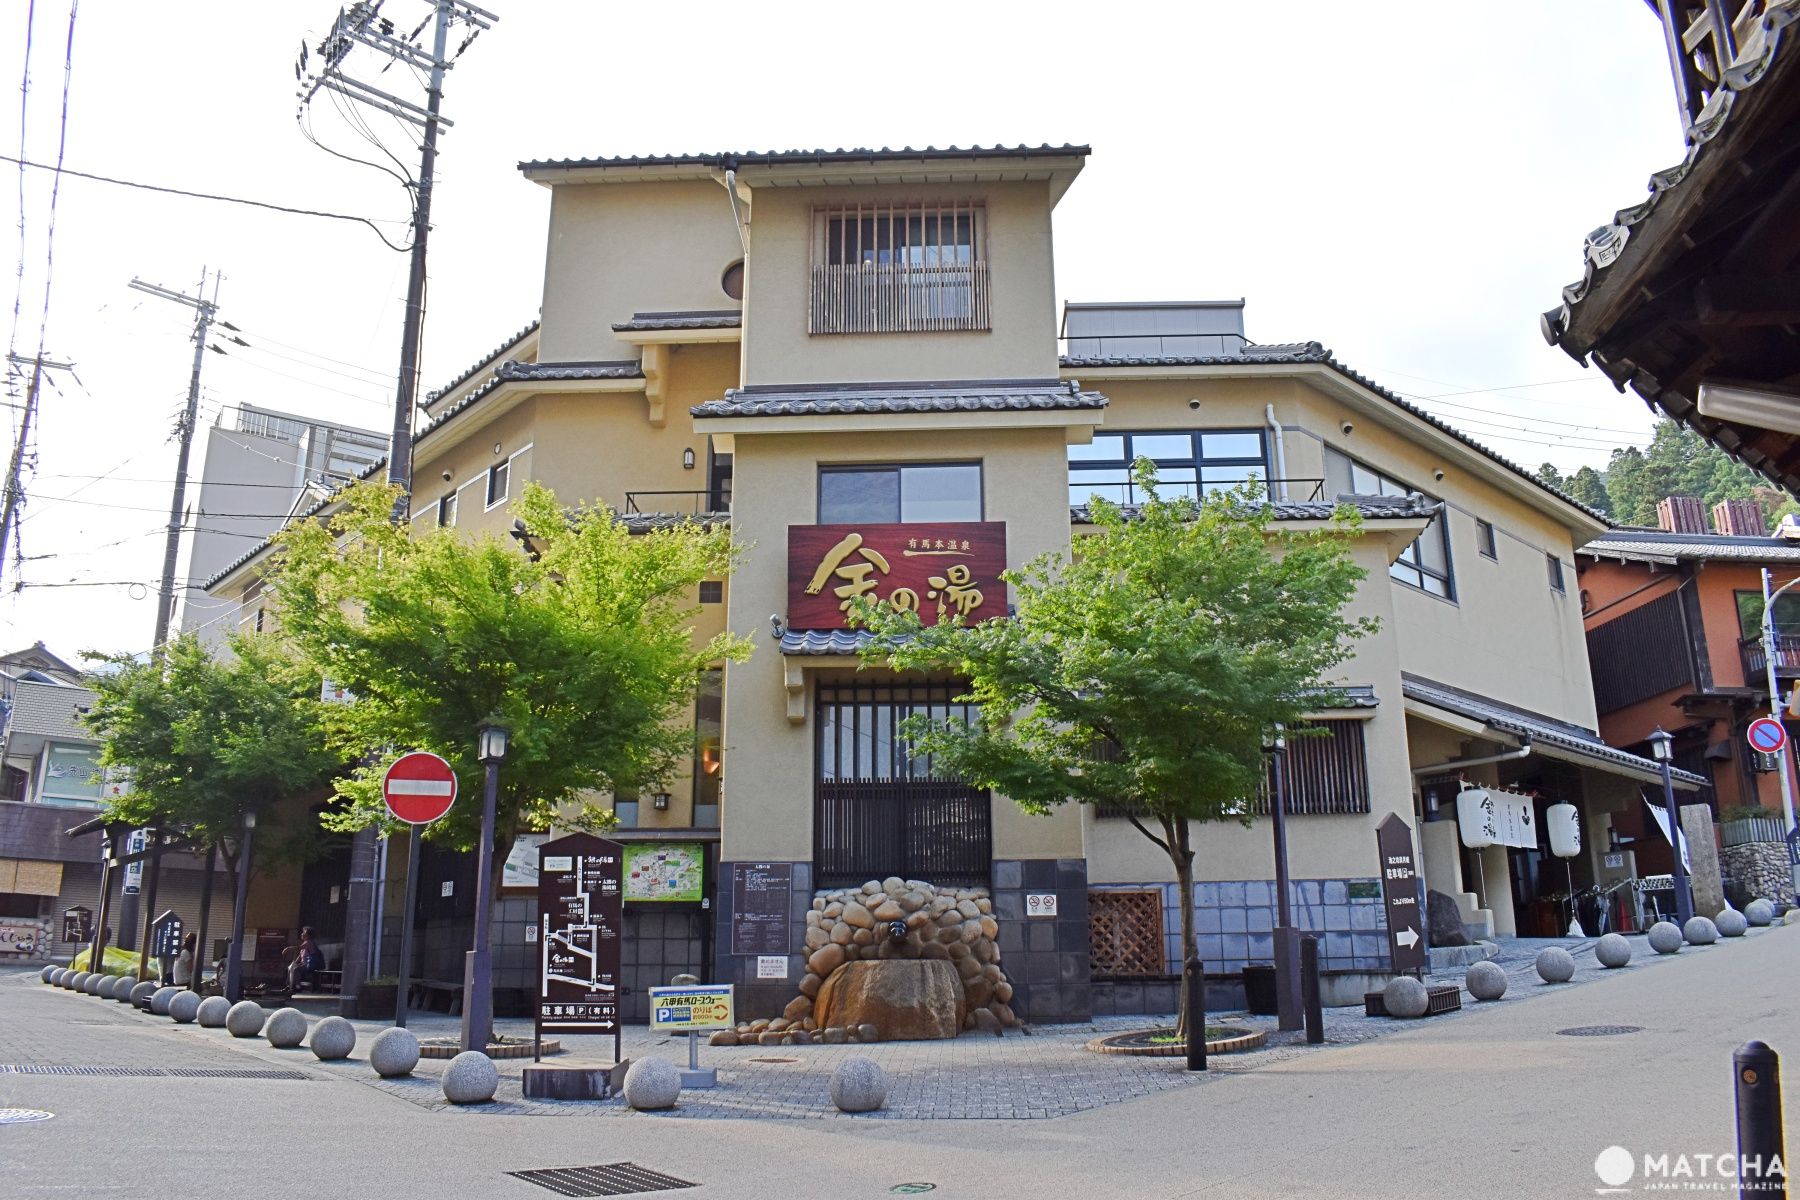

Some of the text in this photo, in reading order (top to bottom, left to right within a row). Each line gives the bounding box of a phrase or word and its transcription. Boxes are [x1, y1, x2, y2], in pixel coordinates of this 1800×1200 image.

[908, 537, 971, 551] 有馬本温泉
[661, 996, 723, 1007] 六甲有馬ロープウェー
[541, 1005, 575, 1015] 駐車場
[658, 1009, 670, 1021] P
